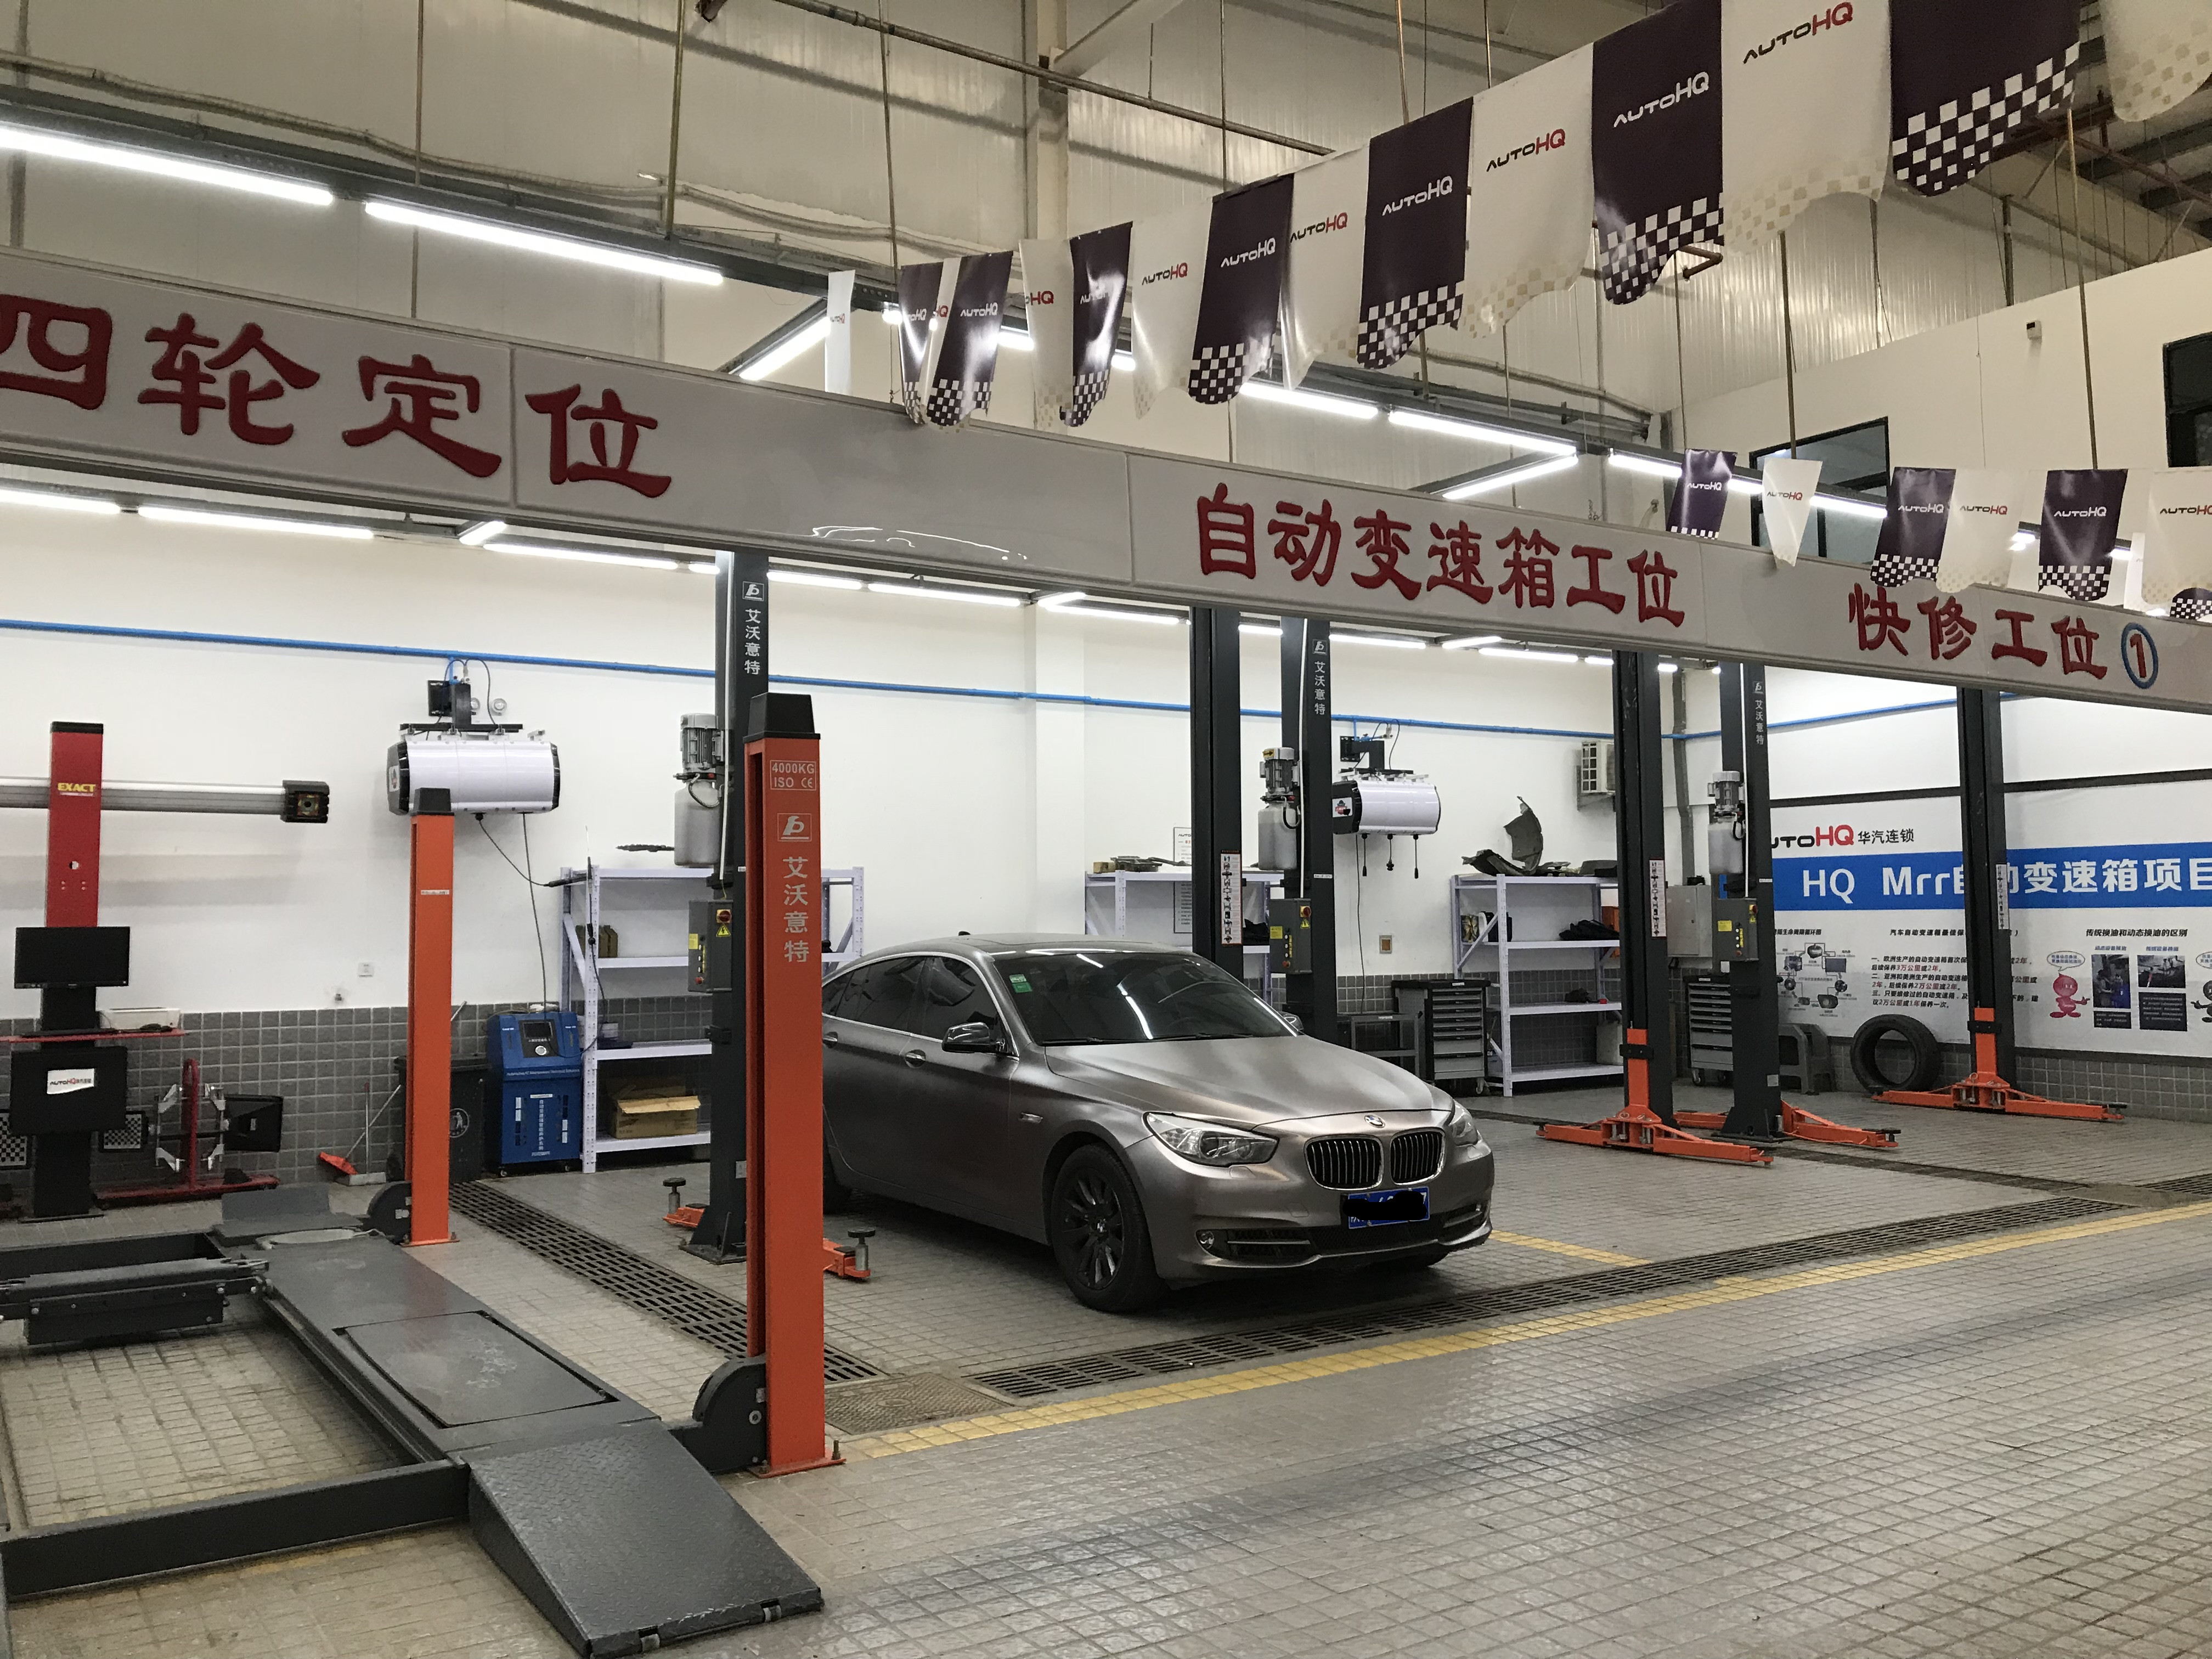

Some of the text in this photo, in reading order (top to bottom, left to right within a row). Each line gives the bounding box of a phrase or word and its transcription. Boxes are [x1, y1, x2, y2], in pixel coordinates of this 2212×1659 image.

[1743, 2, 1853, 64] AUTOHQ
[1613, 71, 1709, 128] AUTOHQ
[1486, 128, 1565, 172] AUTOHQ
[1382, 176, 1452, 216] AUTOHQ
[1290, 212, 1348, 243] AUTOHQ
[1221, 238, 1276, 268] AUTOHQ
[1142, 262, 1188, 285] AUTOHQ
[960, 302, 998, 317] AUTOHQ
[0, 294, 673, 498] 四轮定位
[1687, 482, 1722, 491] AUTOHQ
[1767, 492, 1803, 500] AUTOHQ
[1898, 503, 1944, 514] AUTOHQ
[1960, 505, 2008, 515] AUTOHQ
[2054, 506, 2107, 517] AUTOHQ
[1196, 482, 1685, 628] 自动变速箱工位
[744, 608, 761, 675] 艾沃意特
[1314, 661, 1326, 715] 艾沃意特
[1755, 699, 1764, 745] 艾沃意特
[772, 763, 815, 774] 4000KG
[774, 777, 794, 788] ISO
[58, 782, 96, 792] EXACT
[1858, 828, 1914, 845] 华汽连锁
[1803, 868, 1855, 904] HQ
[783, 856, 809, 963] 艾沃意特
